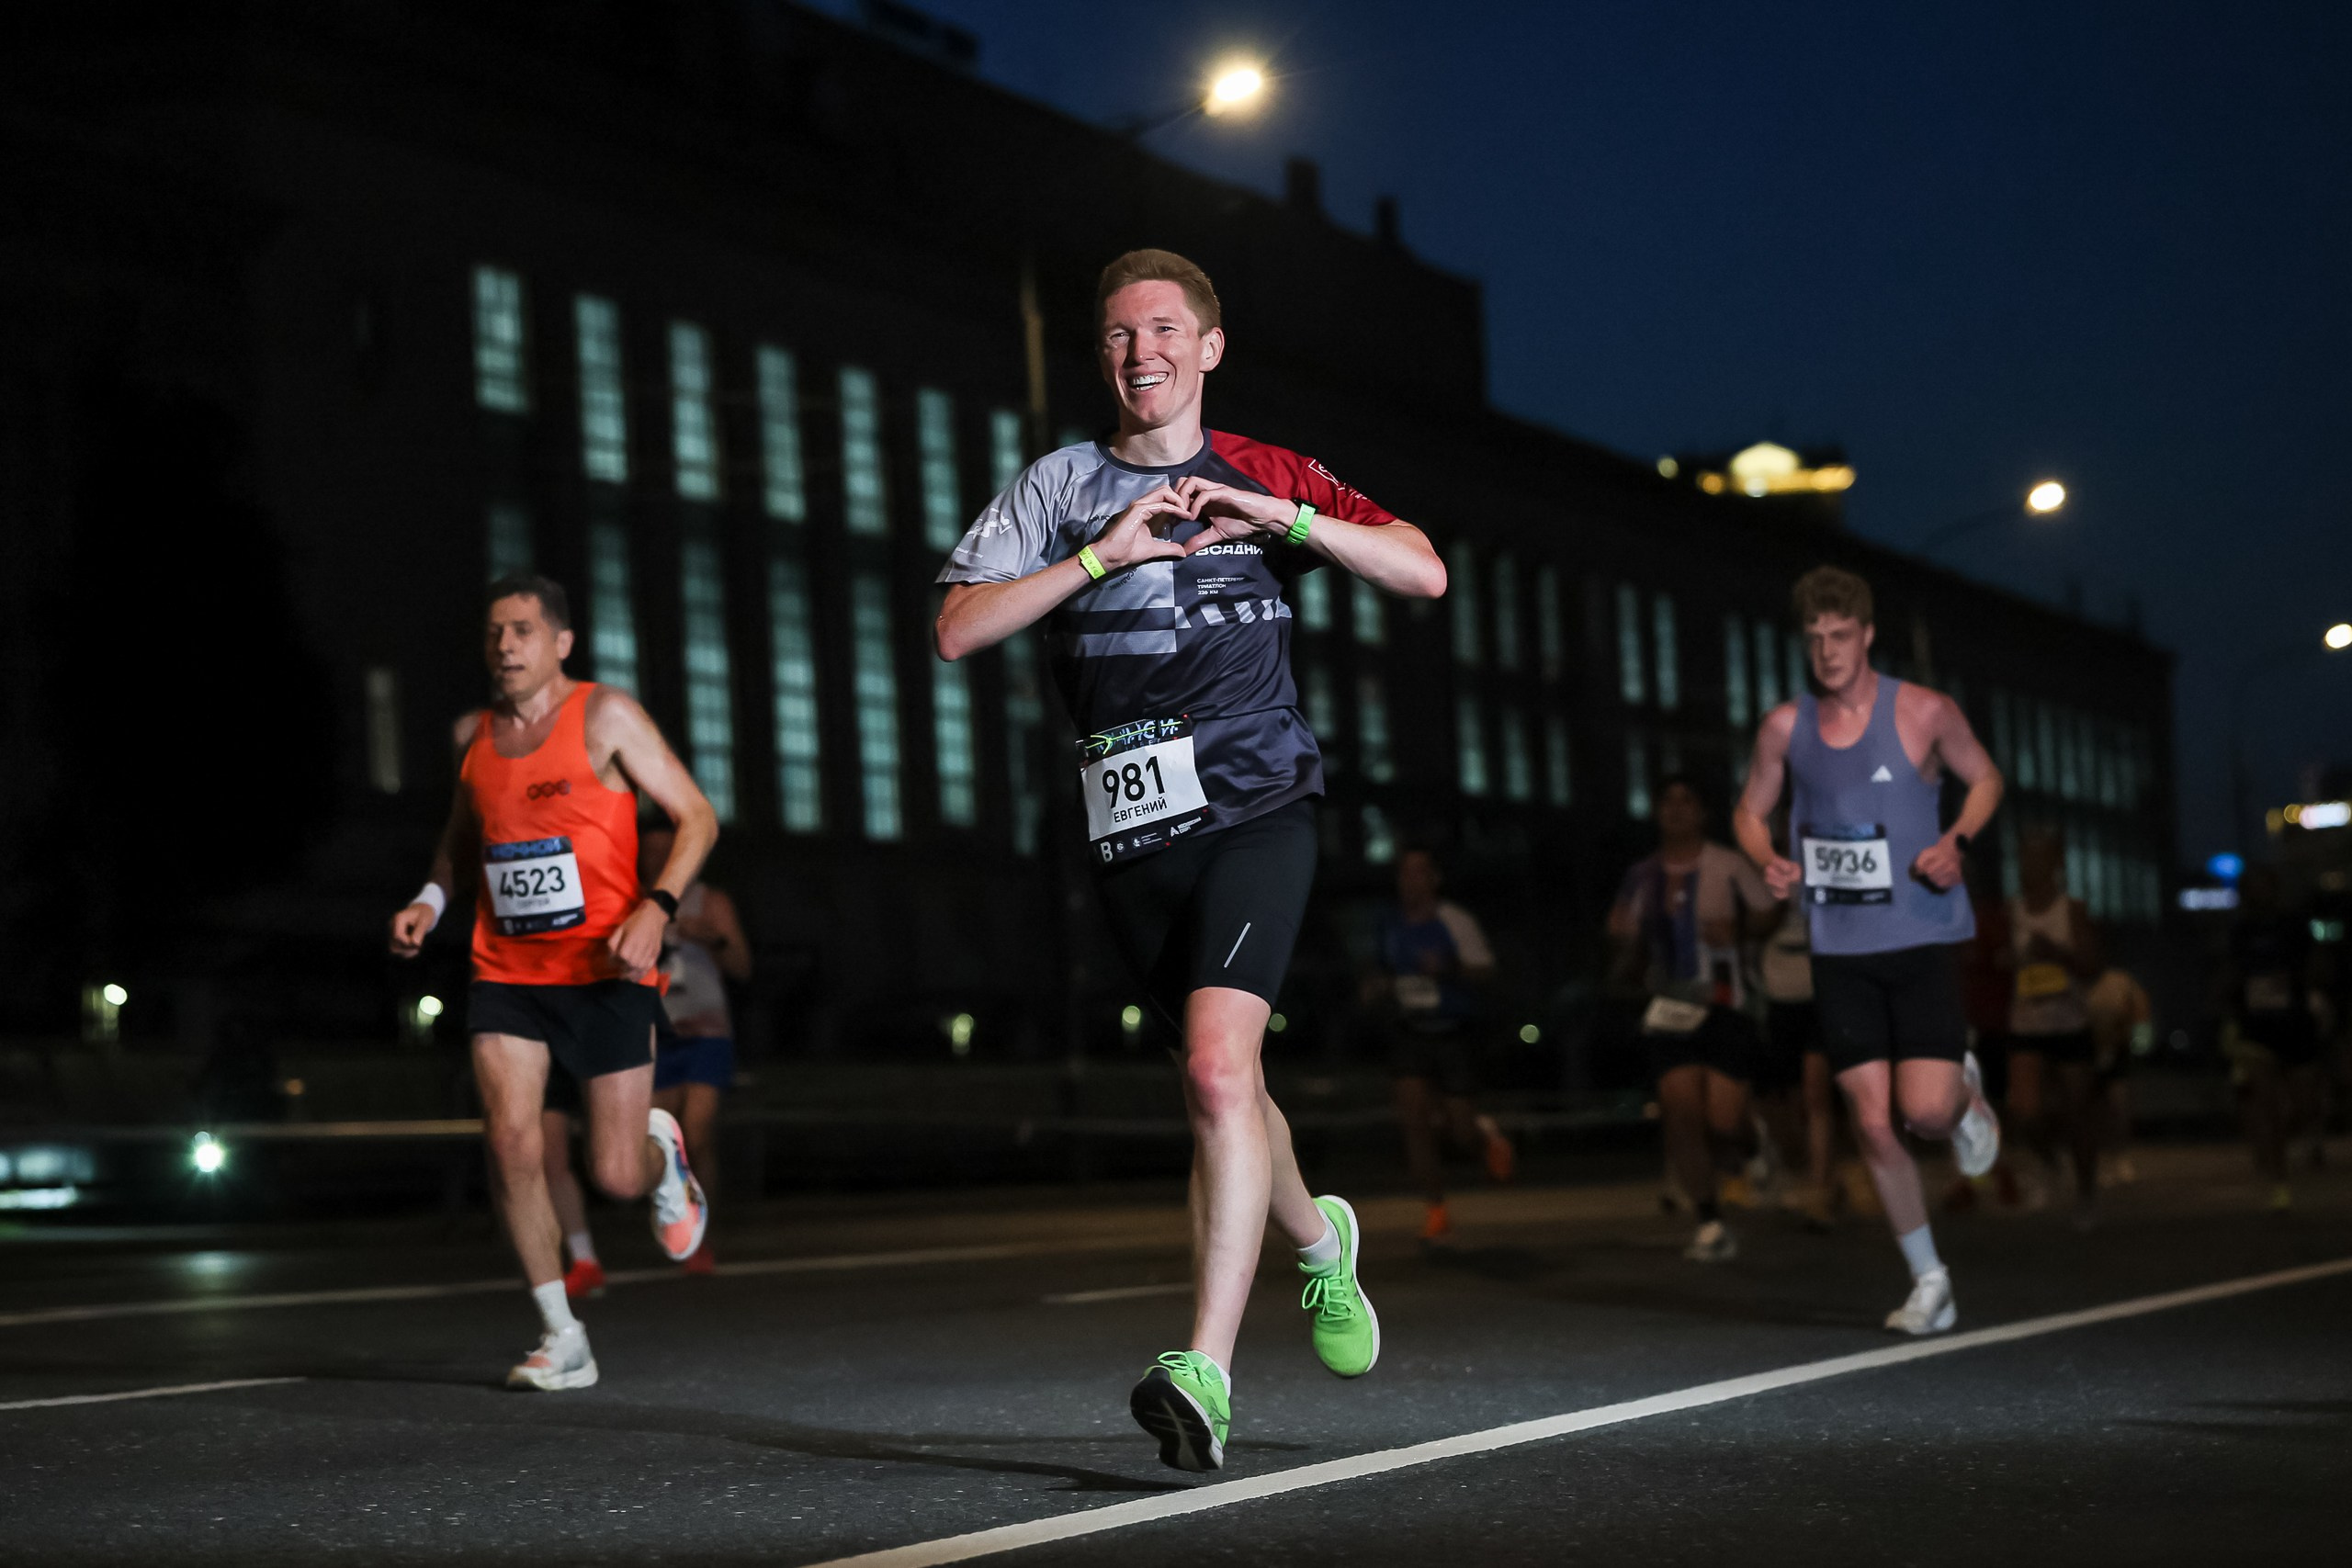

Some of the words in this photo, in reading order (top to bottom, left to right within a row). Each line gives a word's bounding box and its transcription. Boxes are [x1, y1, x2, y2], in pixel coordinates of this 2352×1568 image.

[1102, 755, 1165, 809] 981
[1114, 795, 1168, 823] ЕВГЕНИЙ
[1815, 846, 1877, 874] 5936
[499, 865, 566, 898] 4523
